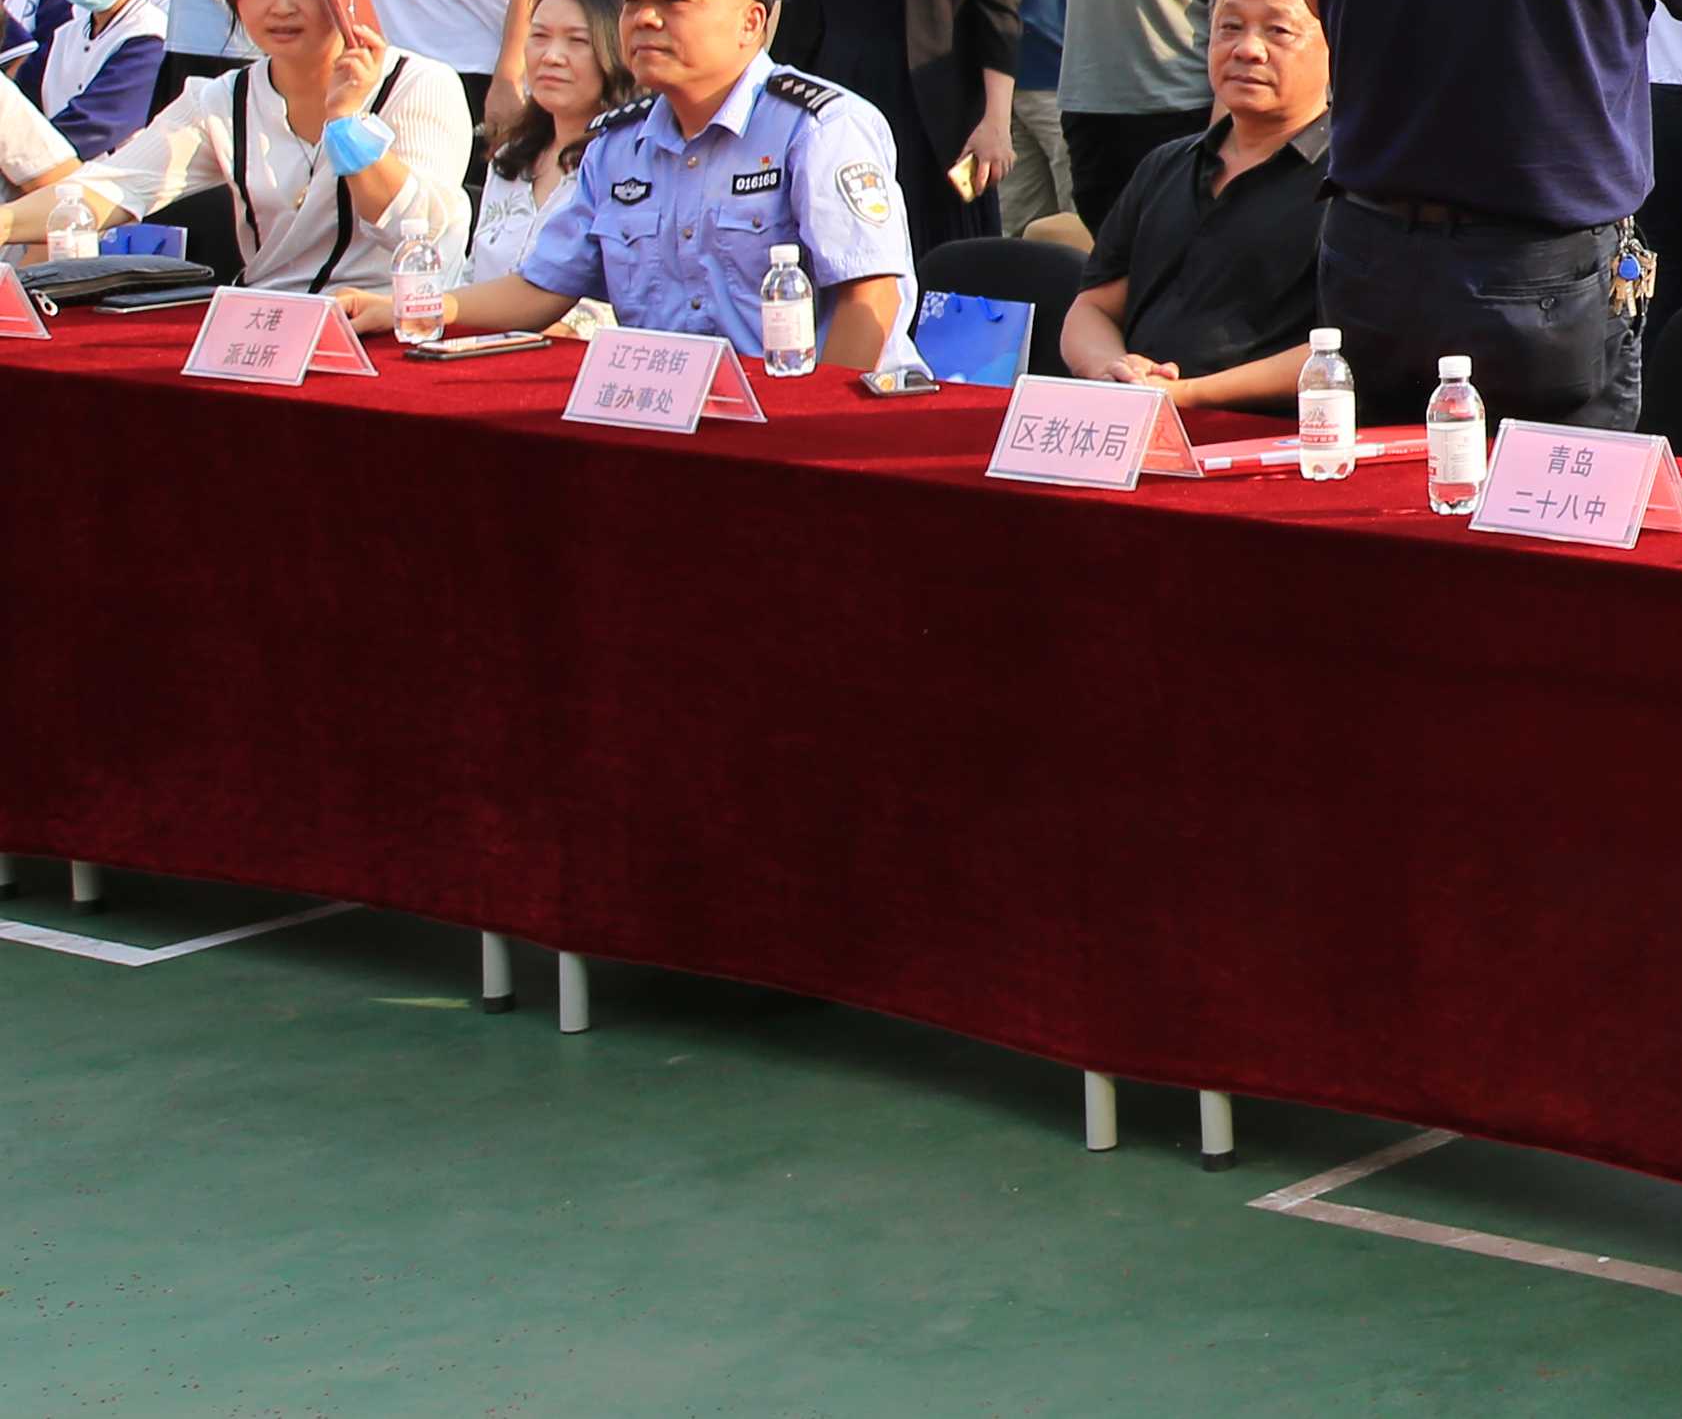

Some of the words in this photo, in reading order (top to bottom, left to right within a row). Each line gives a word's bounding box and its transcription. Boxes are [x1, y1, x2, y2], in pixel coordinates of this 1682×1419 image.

[245, 307, 283, 332] 大港
[222, 342, 281, 369] 派出所
[609, 343, 690, 377] 辽宁路街
[595, 381, 675, 415] 道办事处
[1010, 412, 1130, 462] 区教体局
[1547, 445, 1594, 477] 青岛
[1508, 488, 1607, 526] 二十八中
